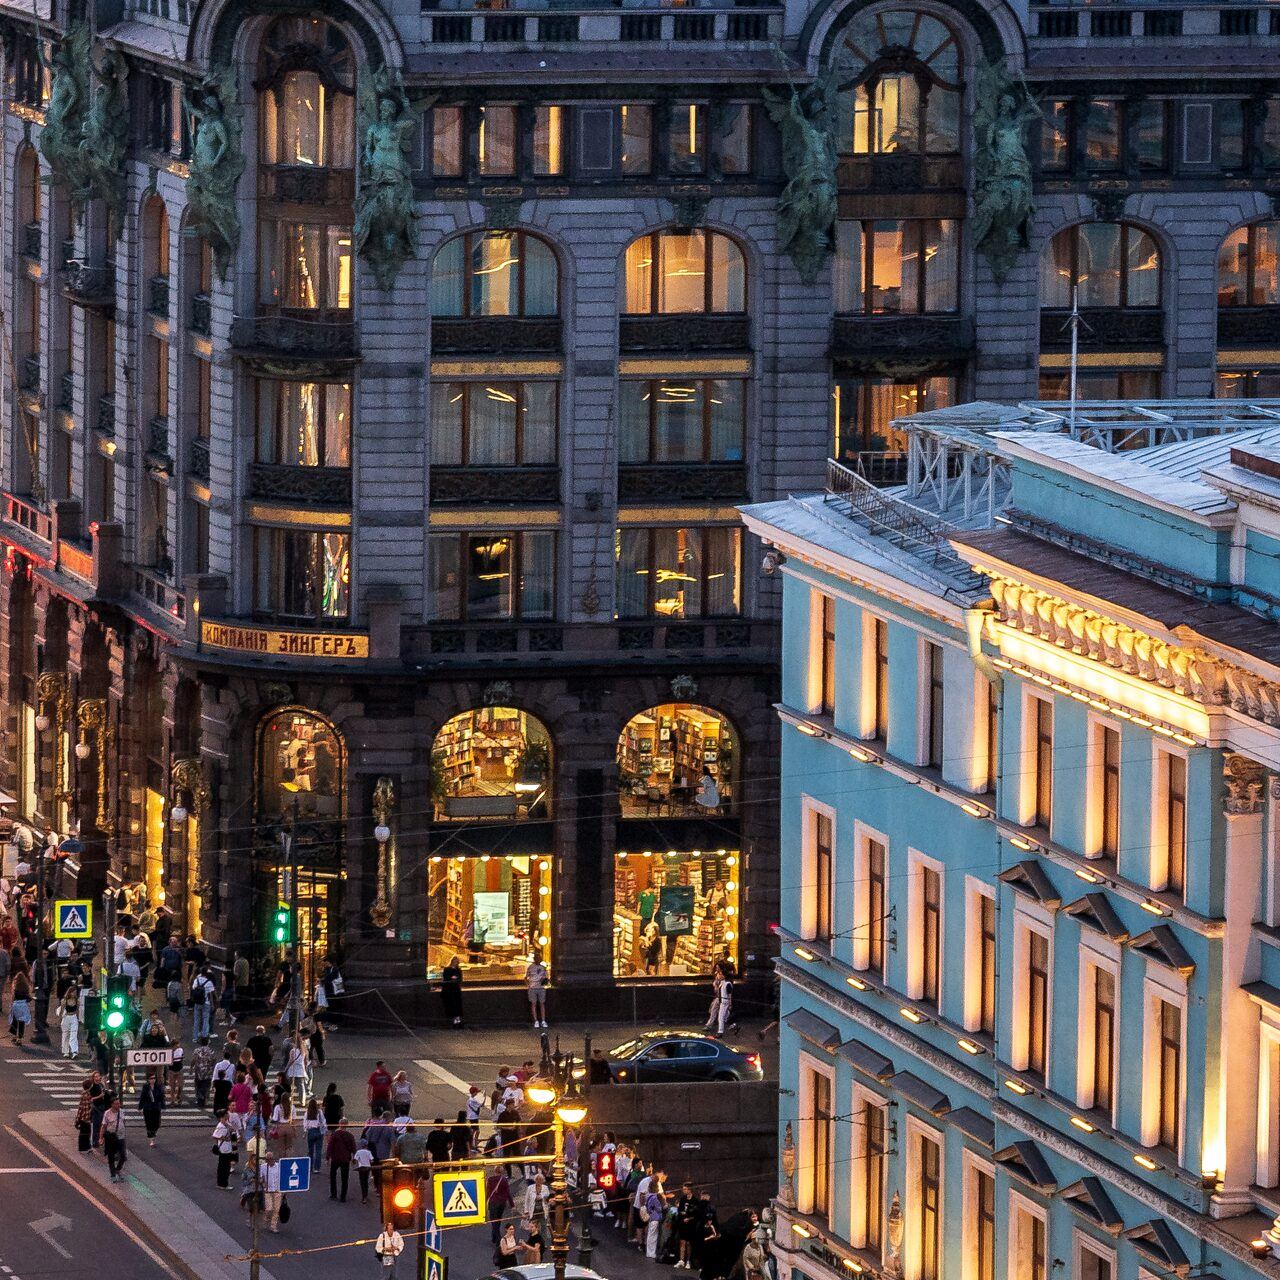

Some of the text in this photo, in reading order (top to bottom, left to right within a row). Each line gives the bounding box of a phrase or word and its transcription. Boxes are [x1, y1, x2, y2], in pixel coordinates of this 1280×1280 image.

[205, 626, 356, 656] КОМПАНІЯ ЗИНГЕРЪ
[133, 1052, 166, 1063] СТОП
